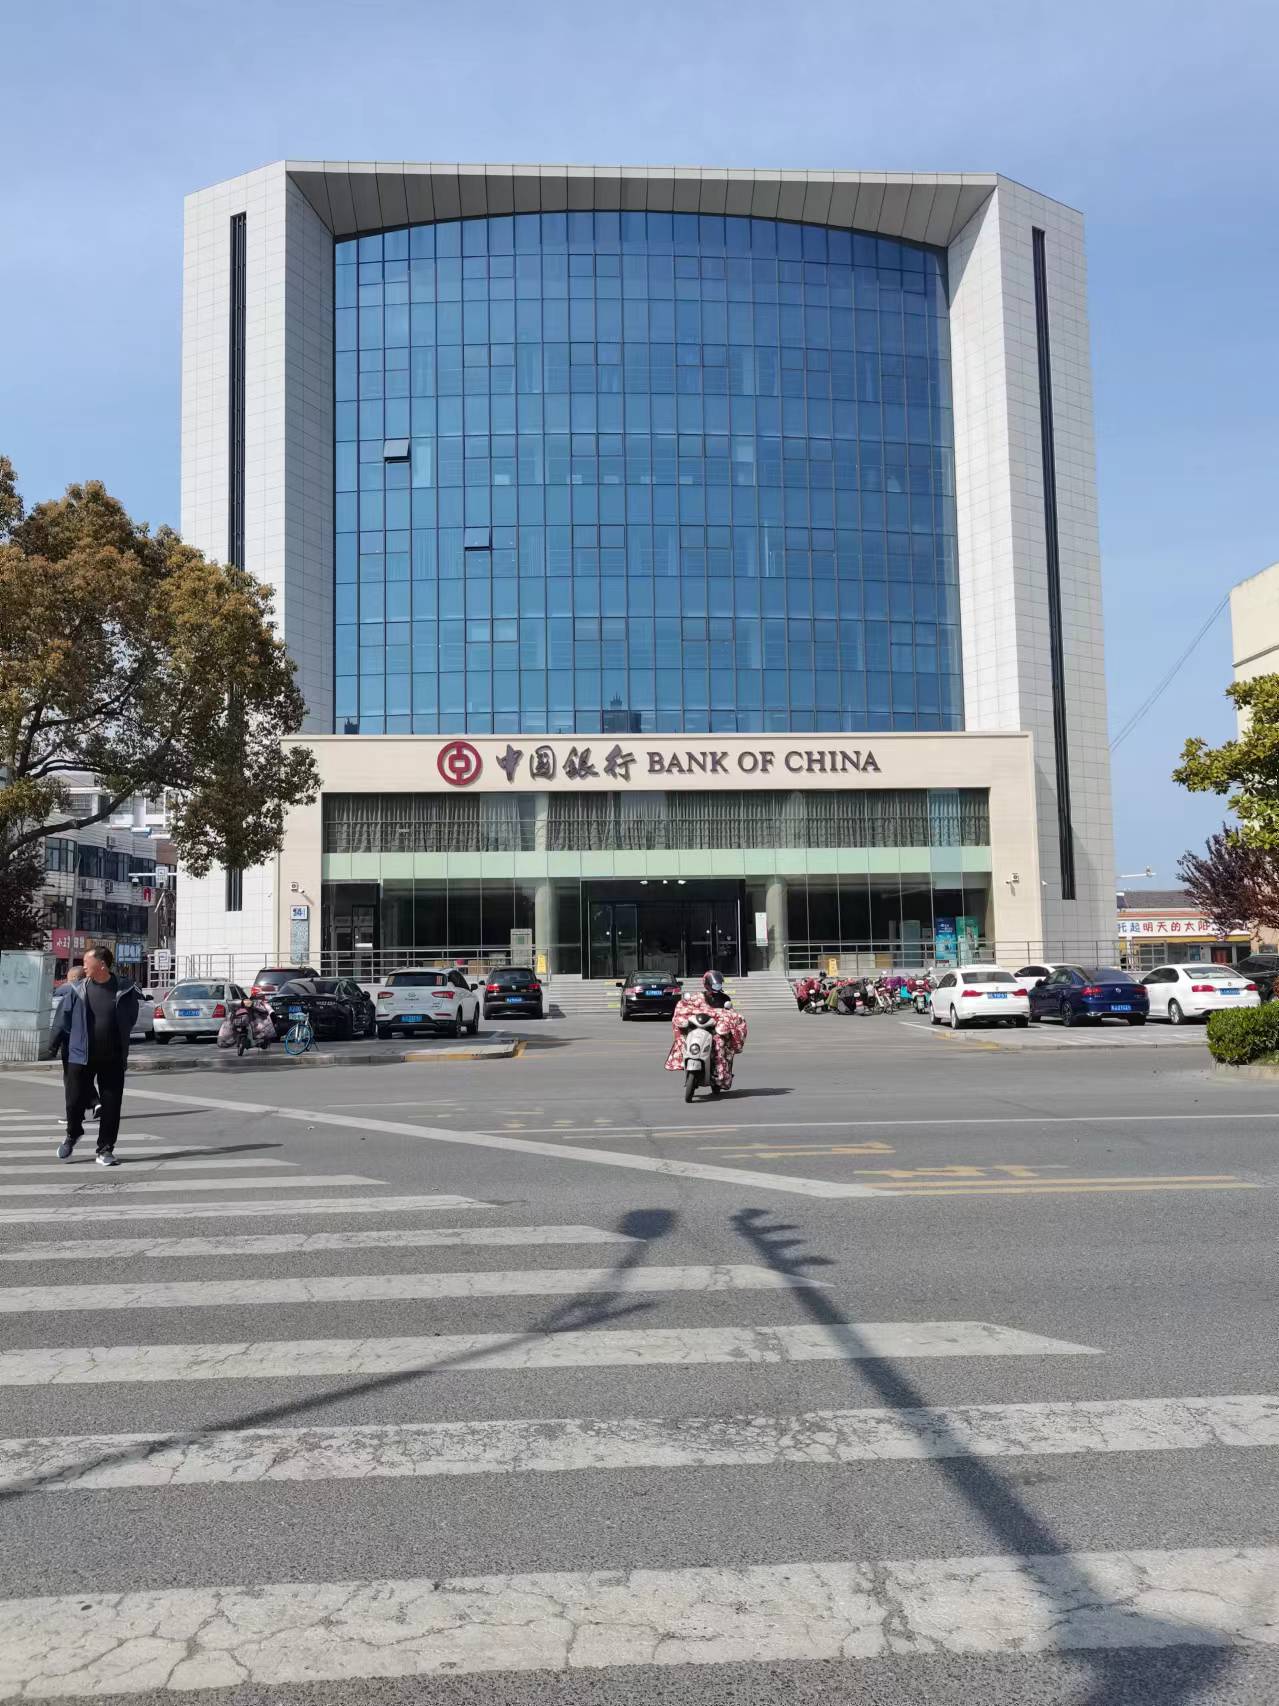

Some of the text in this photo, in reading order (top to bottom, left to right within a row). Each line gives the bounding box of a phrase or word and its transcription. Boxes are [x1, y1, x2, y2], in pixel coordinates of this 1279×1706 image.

[647, 750, 881, 774] BANK OF CHINA
